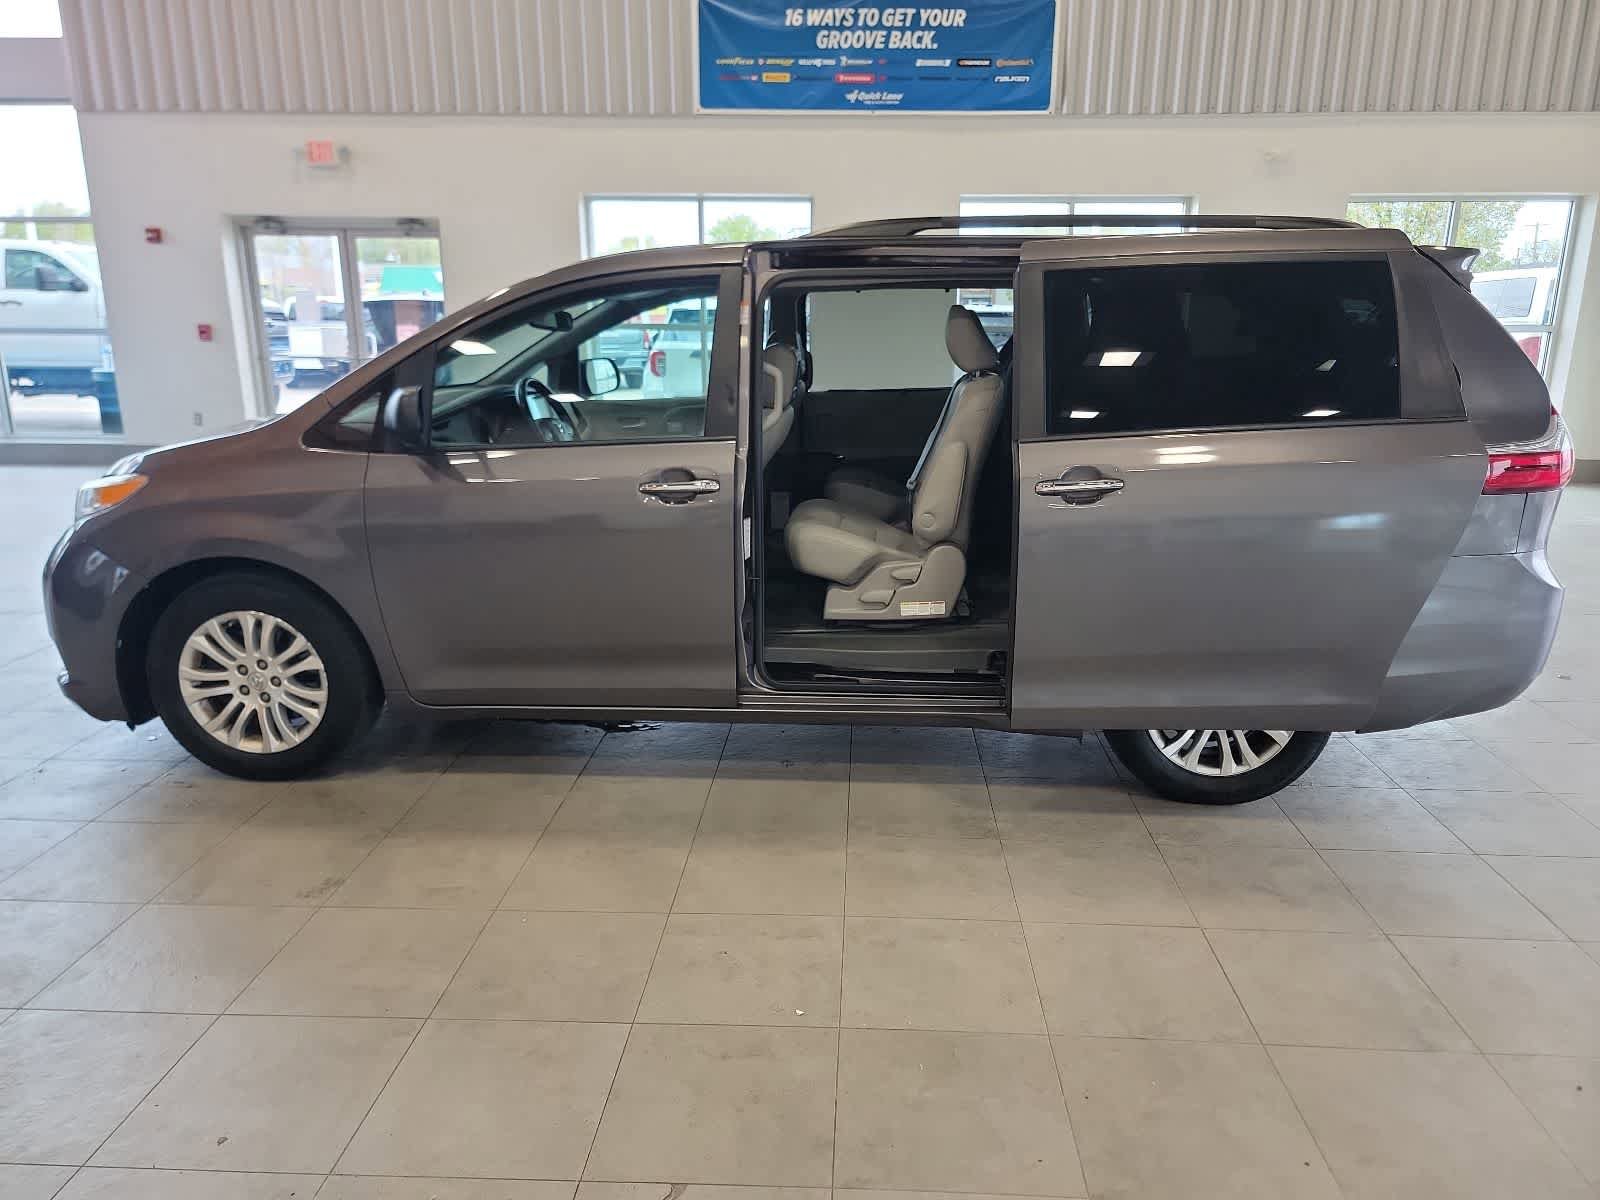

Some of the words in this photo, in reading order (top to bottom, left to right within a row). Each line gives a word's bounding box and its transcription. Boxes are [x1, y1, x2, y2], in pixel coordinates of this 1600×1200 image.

[785, 8, 804, 27] 16
[806, 8, 855, 27] WAYS
[857, 8, 880, 27] TO
[882, 8, 916, 27] GET
[919, 9, 967, 27] YOUR
[816, 29, 888, 50] GROOVE
[888, 30, 939, 50] BACK.
